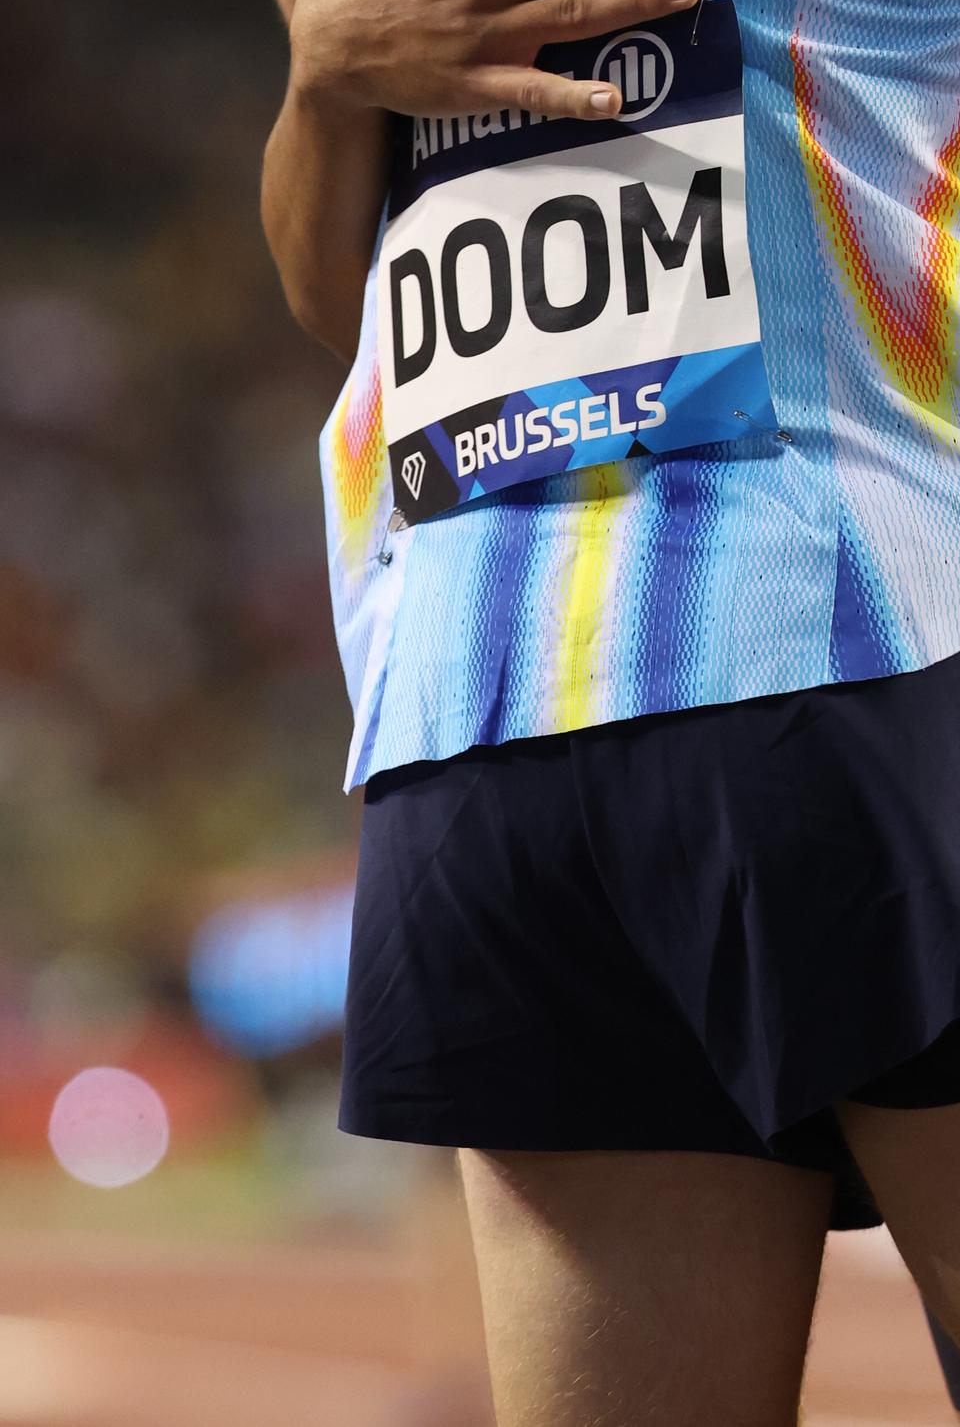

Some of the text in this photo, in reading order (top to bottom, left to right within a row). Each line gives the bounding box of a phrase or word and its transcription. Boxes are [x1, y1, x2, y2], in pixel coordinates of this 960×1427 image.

[412, 71, 574, 171] Allia
[389, 167, 731, 389] DOOM
[455, 383, 667, 478] BRUSSELS
